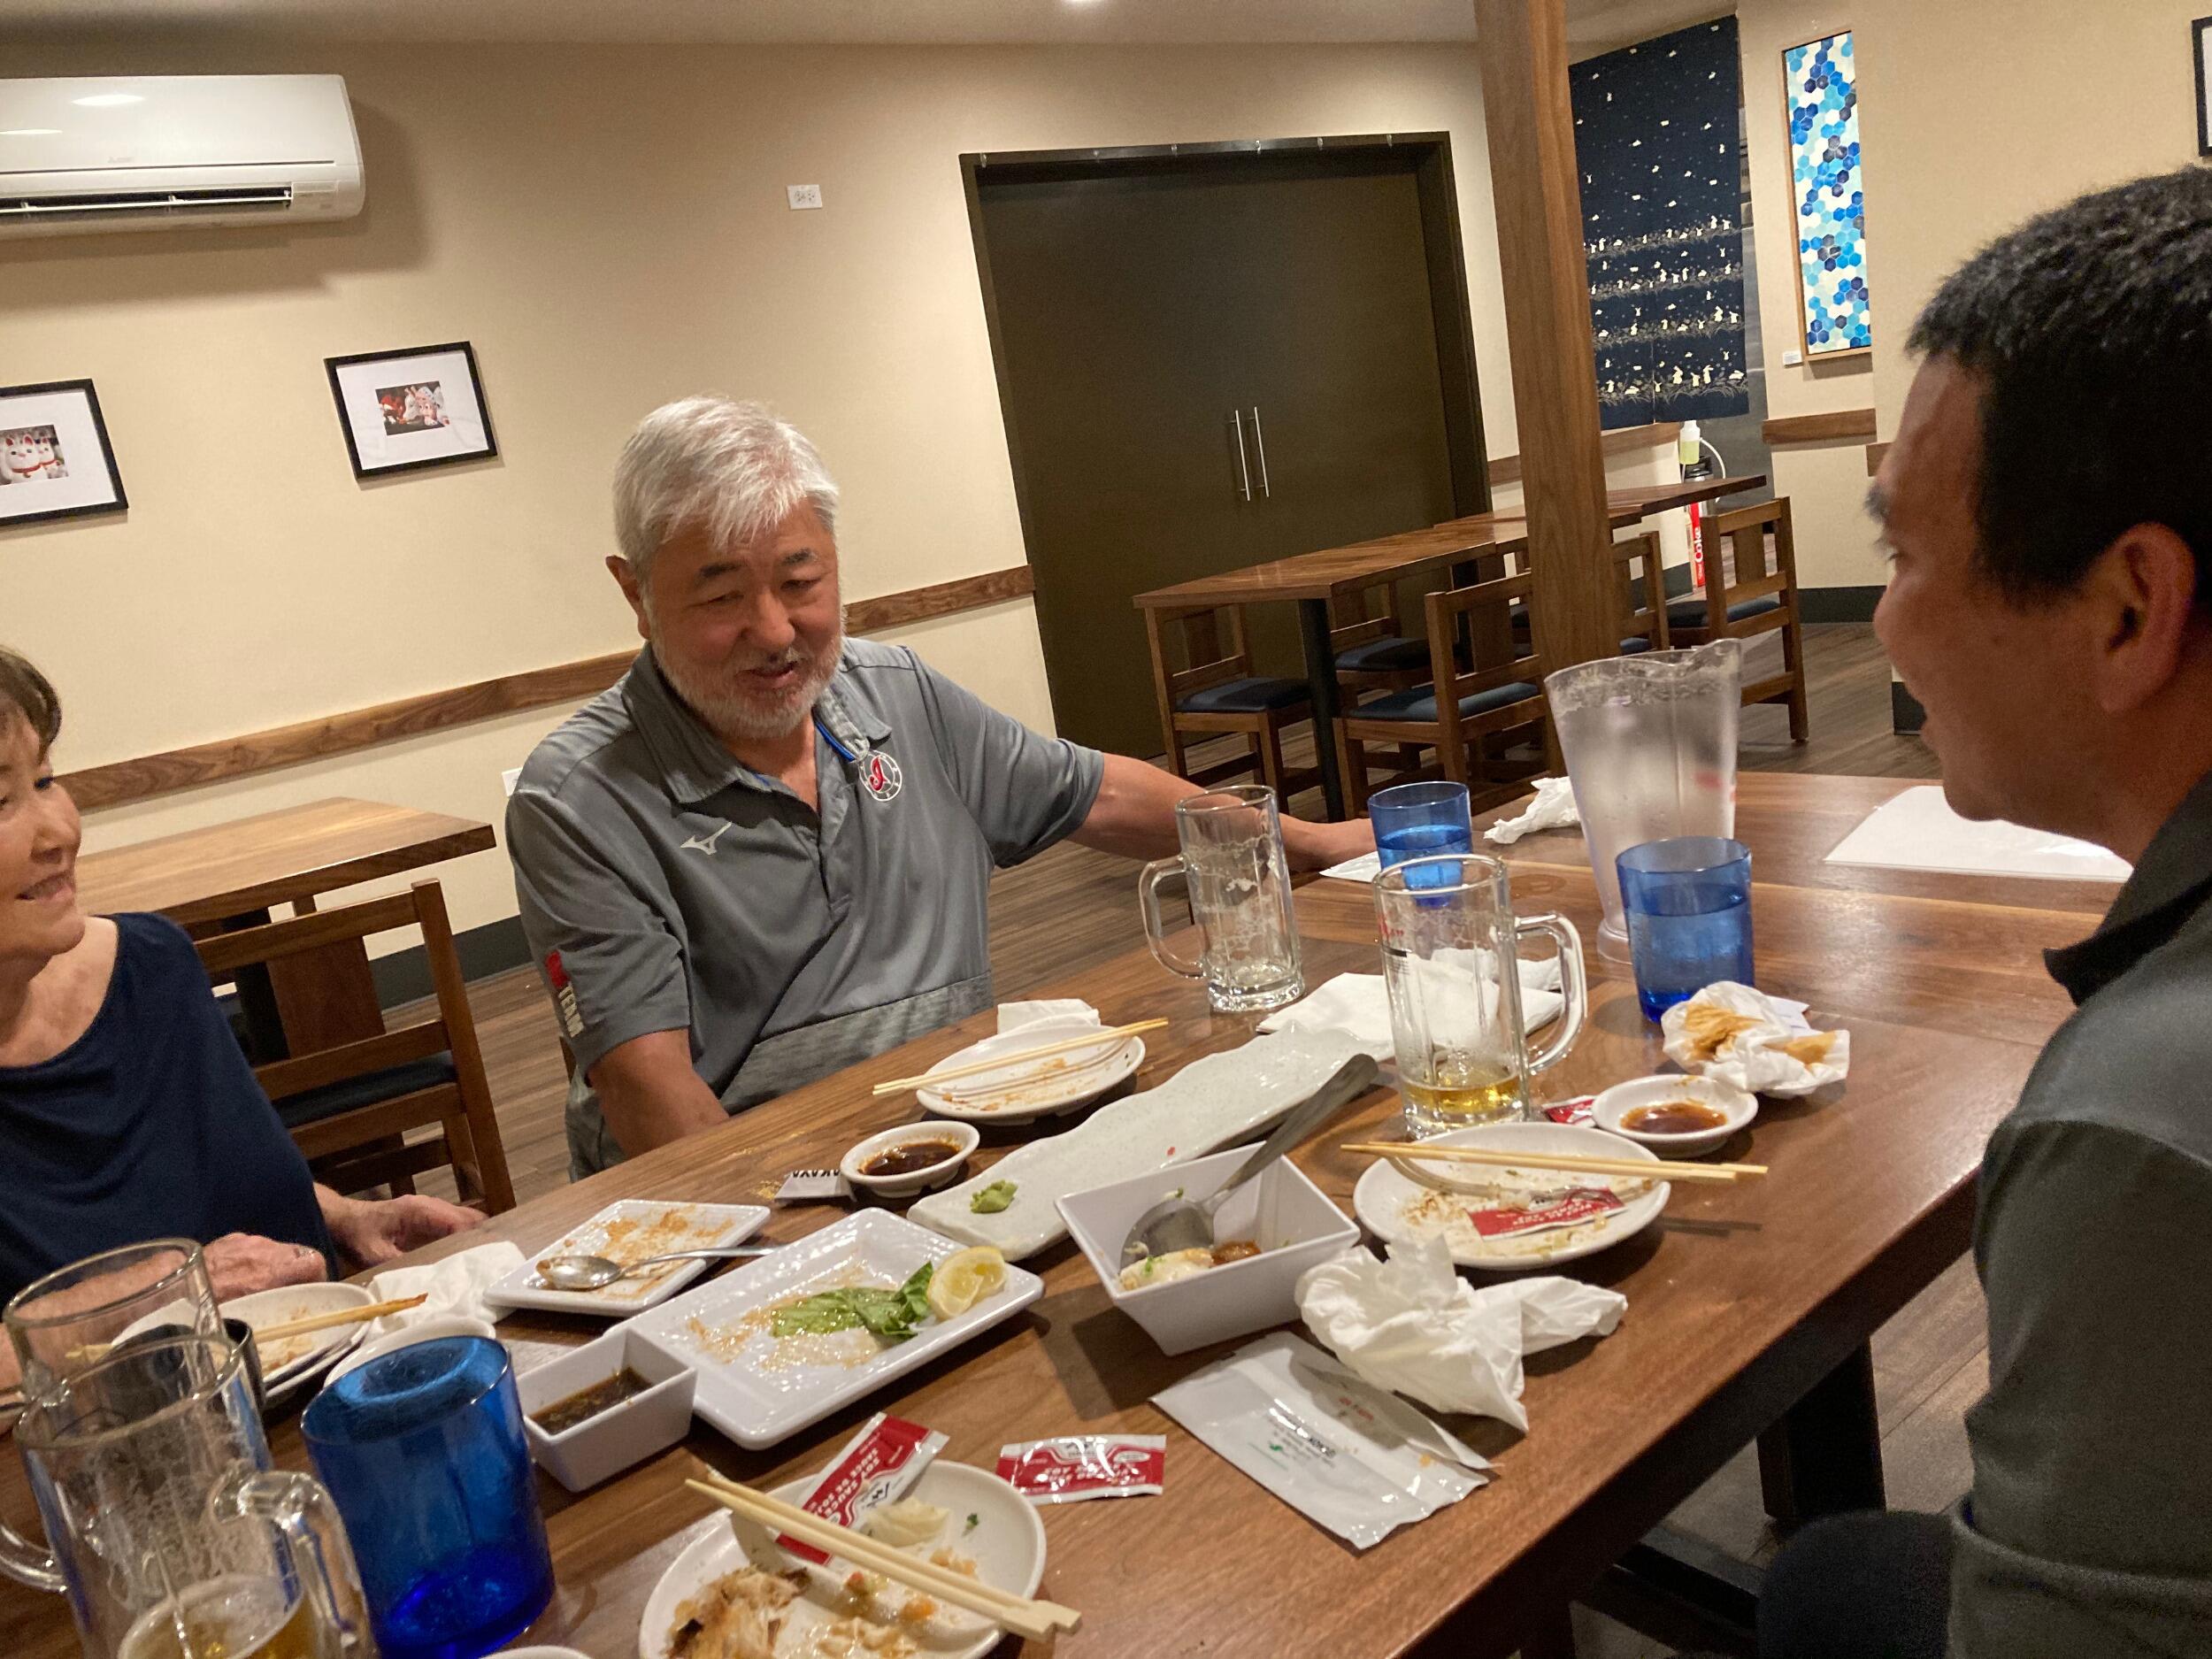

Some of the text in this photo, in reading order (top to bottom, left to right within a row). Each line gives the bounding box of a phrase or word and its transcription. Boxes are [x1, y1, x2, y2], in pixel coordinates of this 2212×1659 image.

[1694, 526, 1703, 562] Coke
[558, 982, 584, 1038] TEAM
[849, 1448, 879, 1478] SAUCE
[861, 1456, 879, 1479] SOY
[825, 1480, 857, 1516] SAUCE
